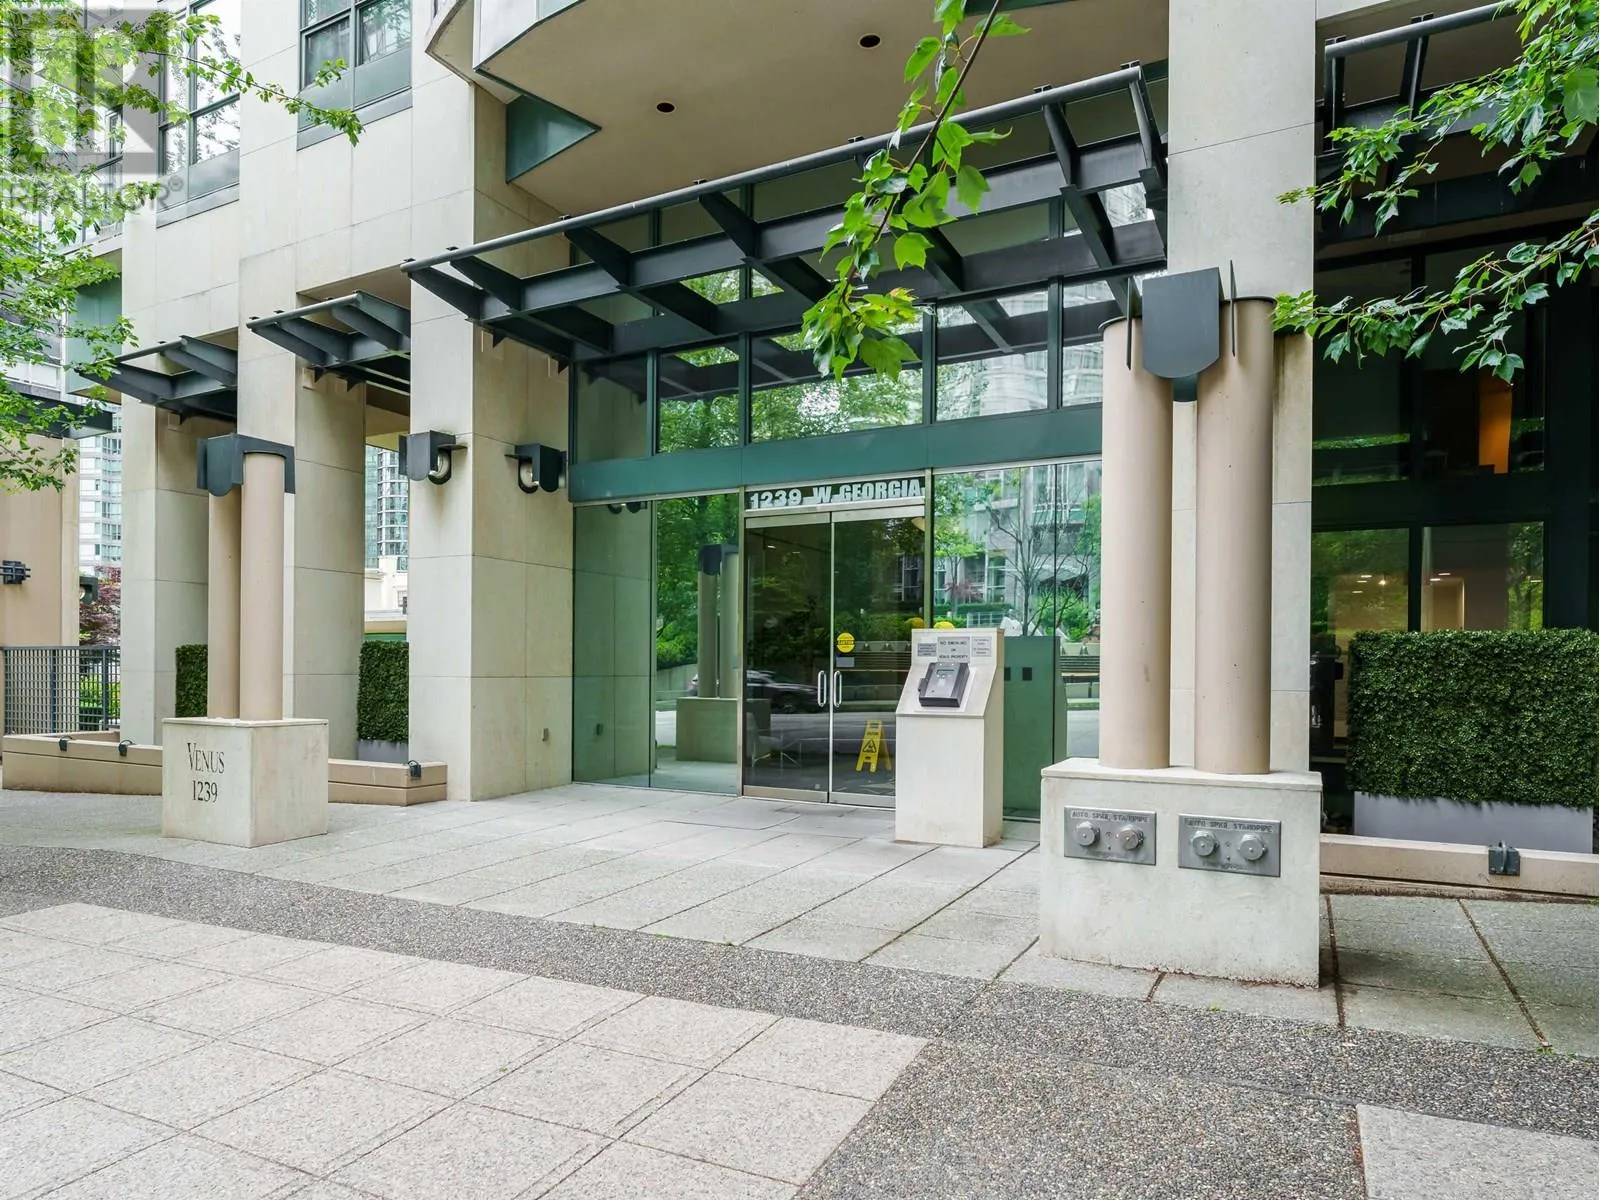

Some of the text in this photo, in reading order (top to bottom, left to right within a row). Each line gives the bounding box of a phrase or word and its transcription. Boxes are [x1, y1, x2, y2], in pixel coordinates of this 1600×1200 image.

[750, 478, 921, 510] 1239 W GEORGIA
[186, 742, 225, 774] VENUS
[192, 780, 218, 803] 1239
